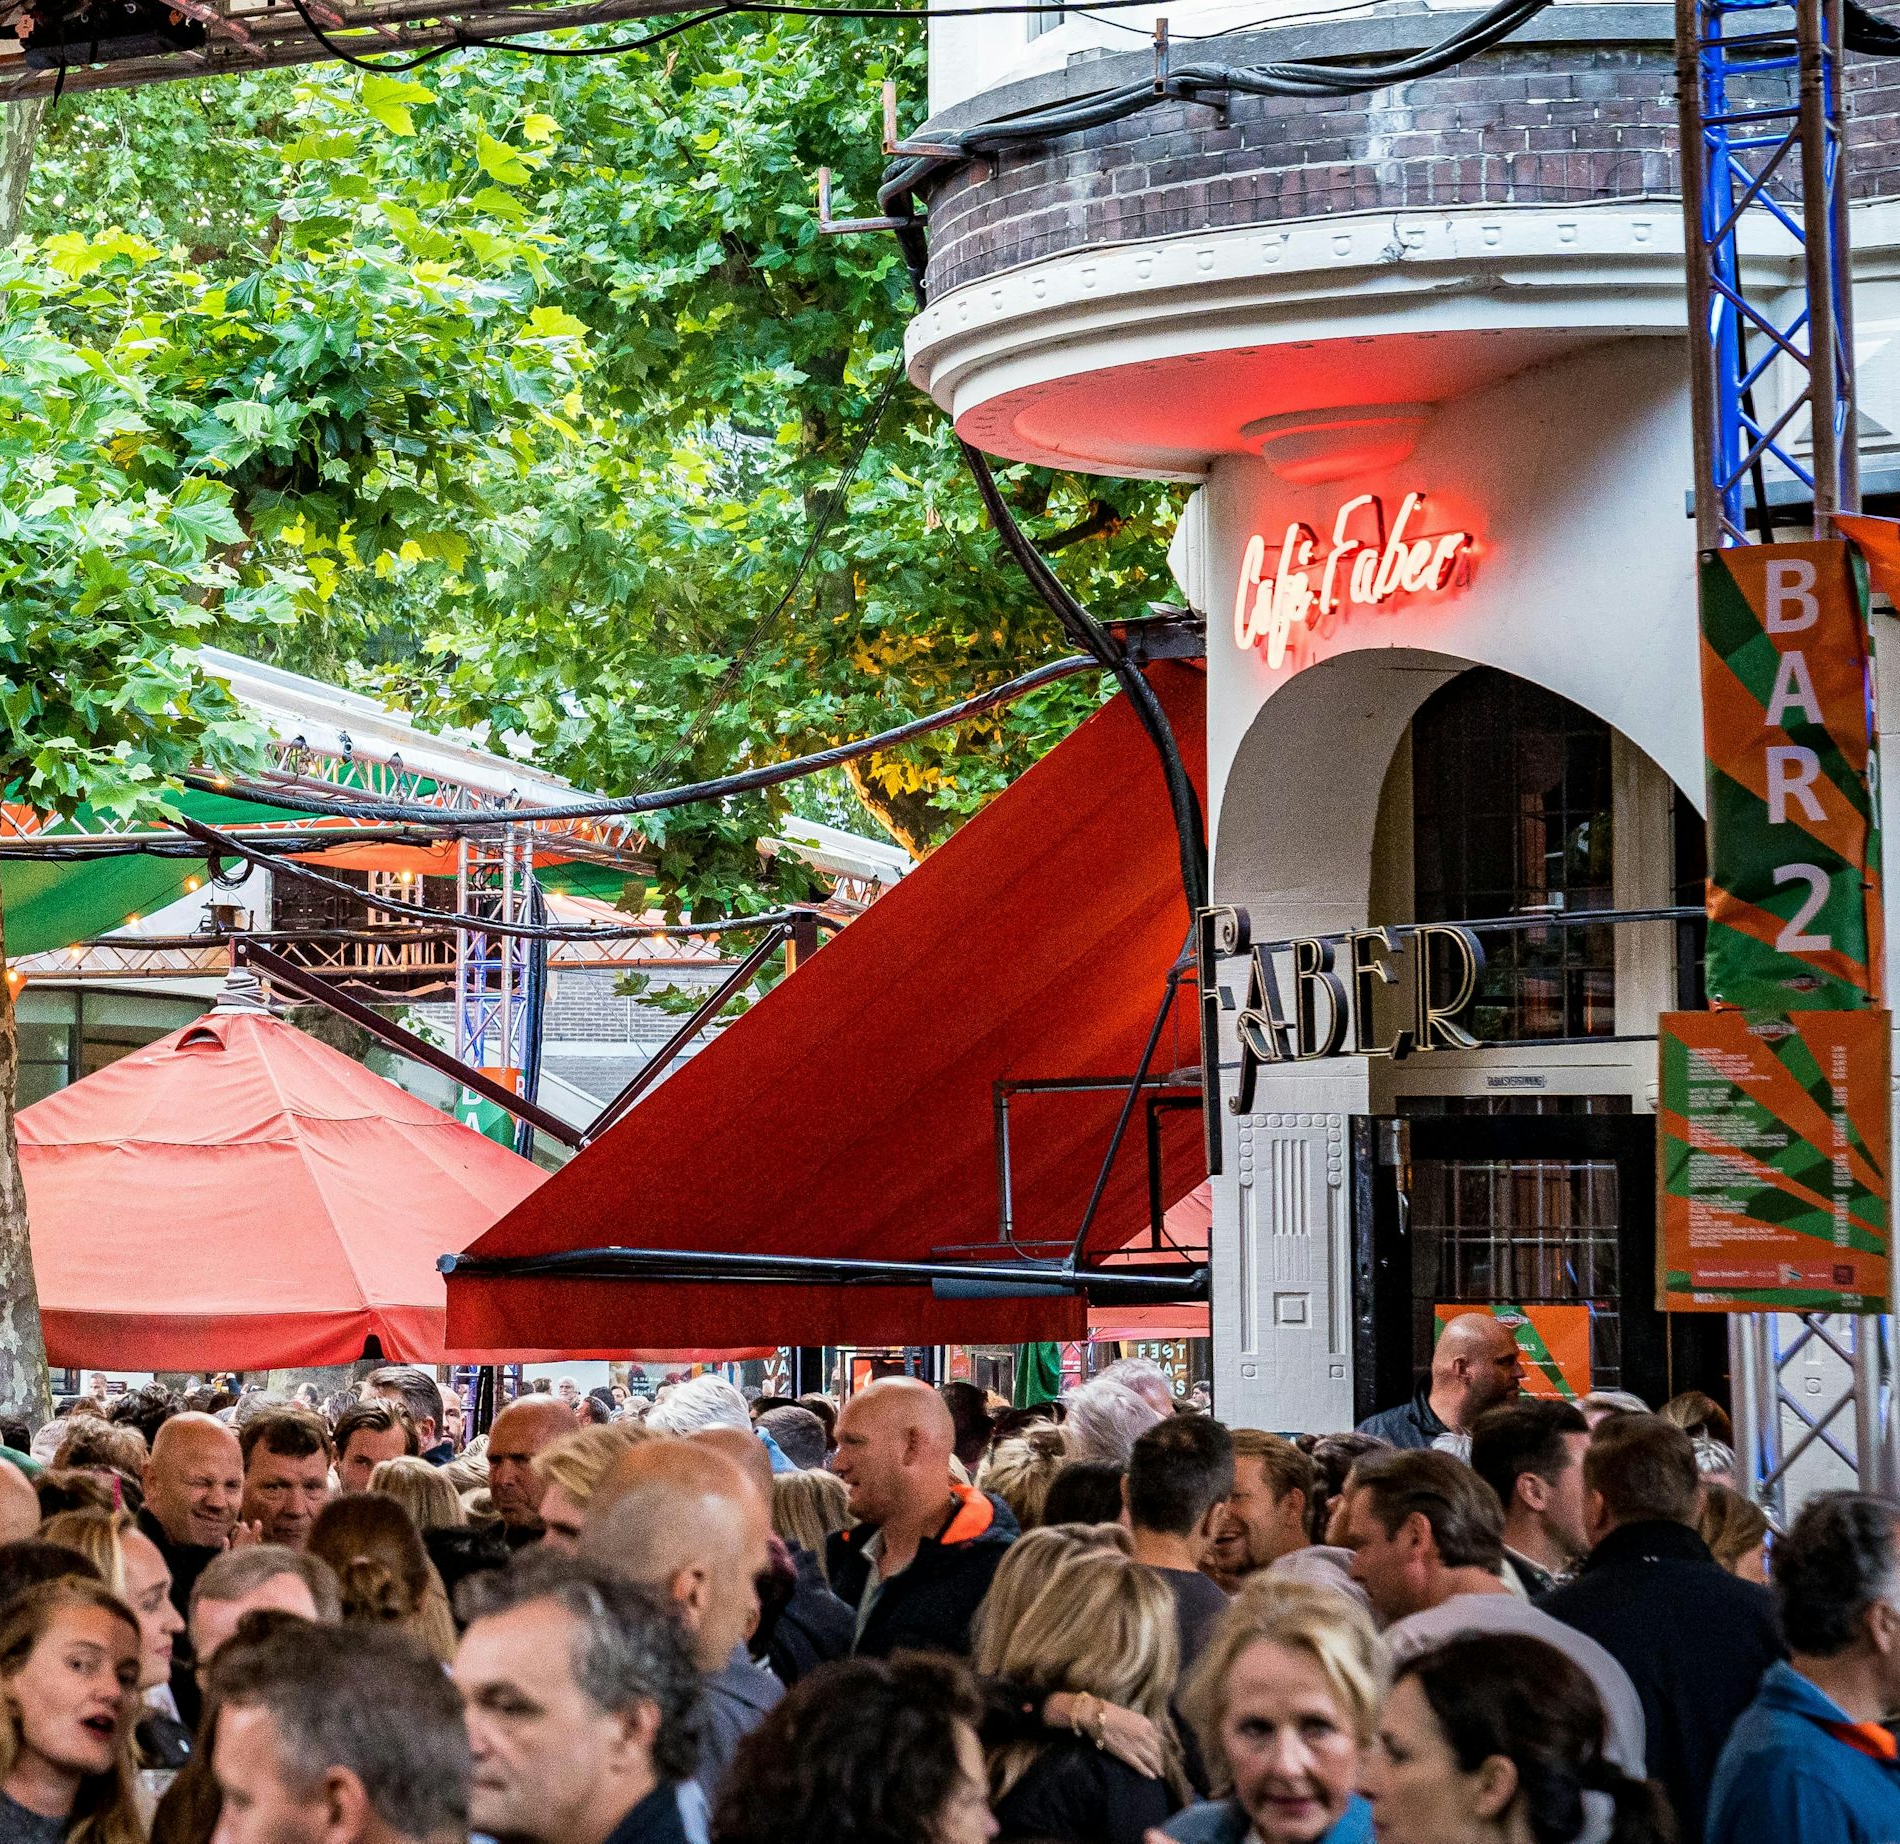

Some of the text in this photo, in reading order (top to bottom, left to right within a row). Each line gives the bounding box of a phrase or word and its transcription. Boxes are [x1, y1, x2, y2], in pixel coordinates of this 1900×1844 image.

[1234, 492, 1465, 670] Café Faber
[1764, 558, 1829, 825] BAR
[1772, 862, 1833, 953] 2
[1196, 903, 1486, 1173] FABER
